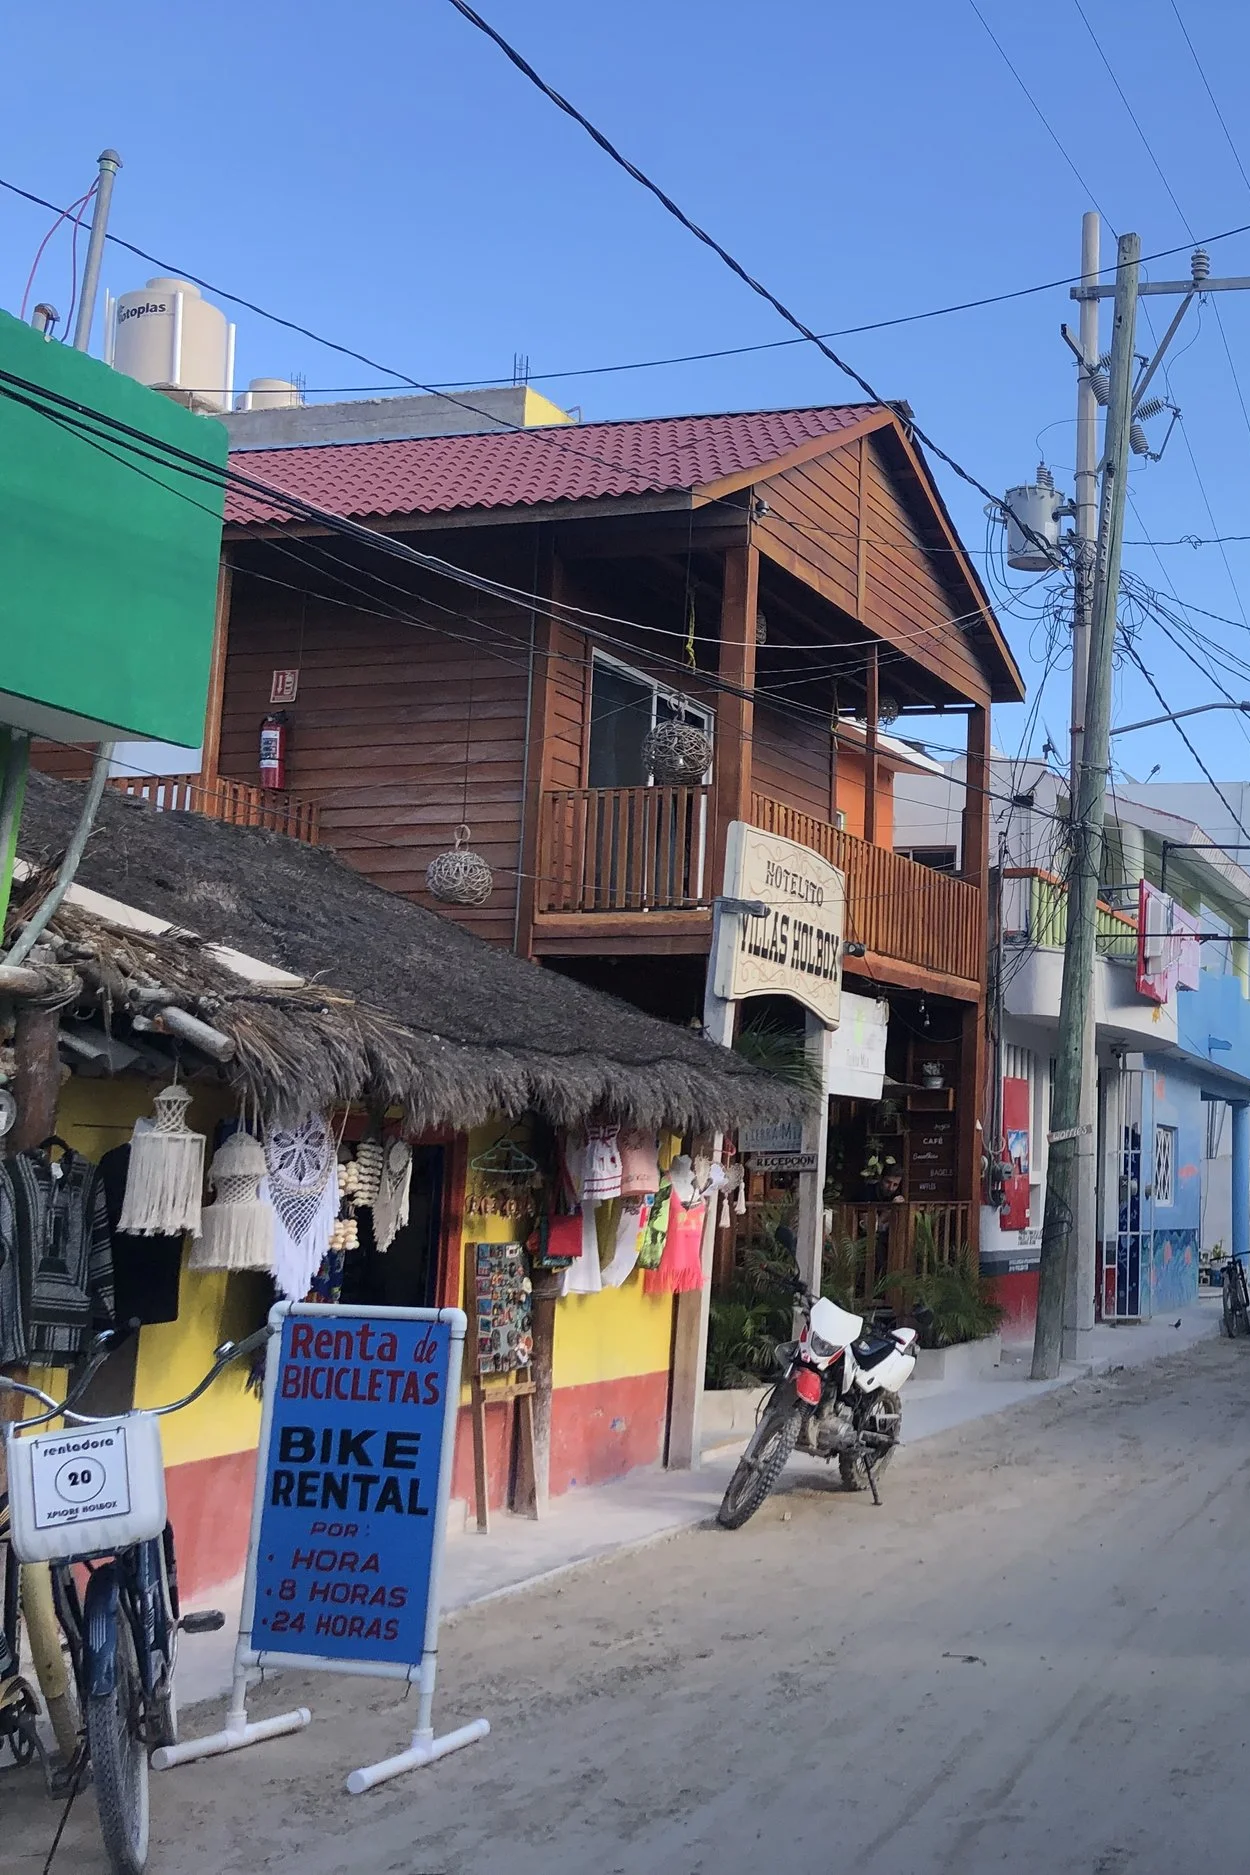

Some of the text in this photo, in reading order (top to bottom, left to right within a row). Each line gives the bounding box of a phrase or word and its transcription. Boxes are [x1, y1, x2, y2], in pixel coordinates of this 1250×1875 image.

[766, 860, 823, 907] HOTELITO
[741, 910, 839, 982] VILLAS HOLBOX
[289, 1320, 438, 1364] Renta de
[282, 1365, 439, 1406] BICICLETAS
[43, 1437, 114, 1457] rentadora
[279, 1426, 421, 1469] BIKE
[68, 1469, 91, 1486] 20
[272, 1469, 429, 1516] RENTAL
[291, 1550, 380, 1573] HORA
[279, 1579, 408, 1607] 8 HORAS
[271, 1611, 399, 1640] 24 HORAS
